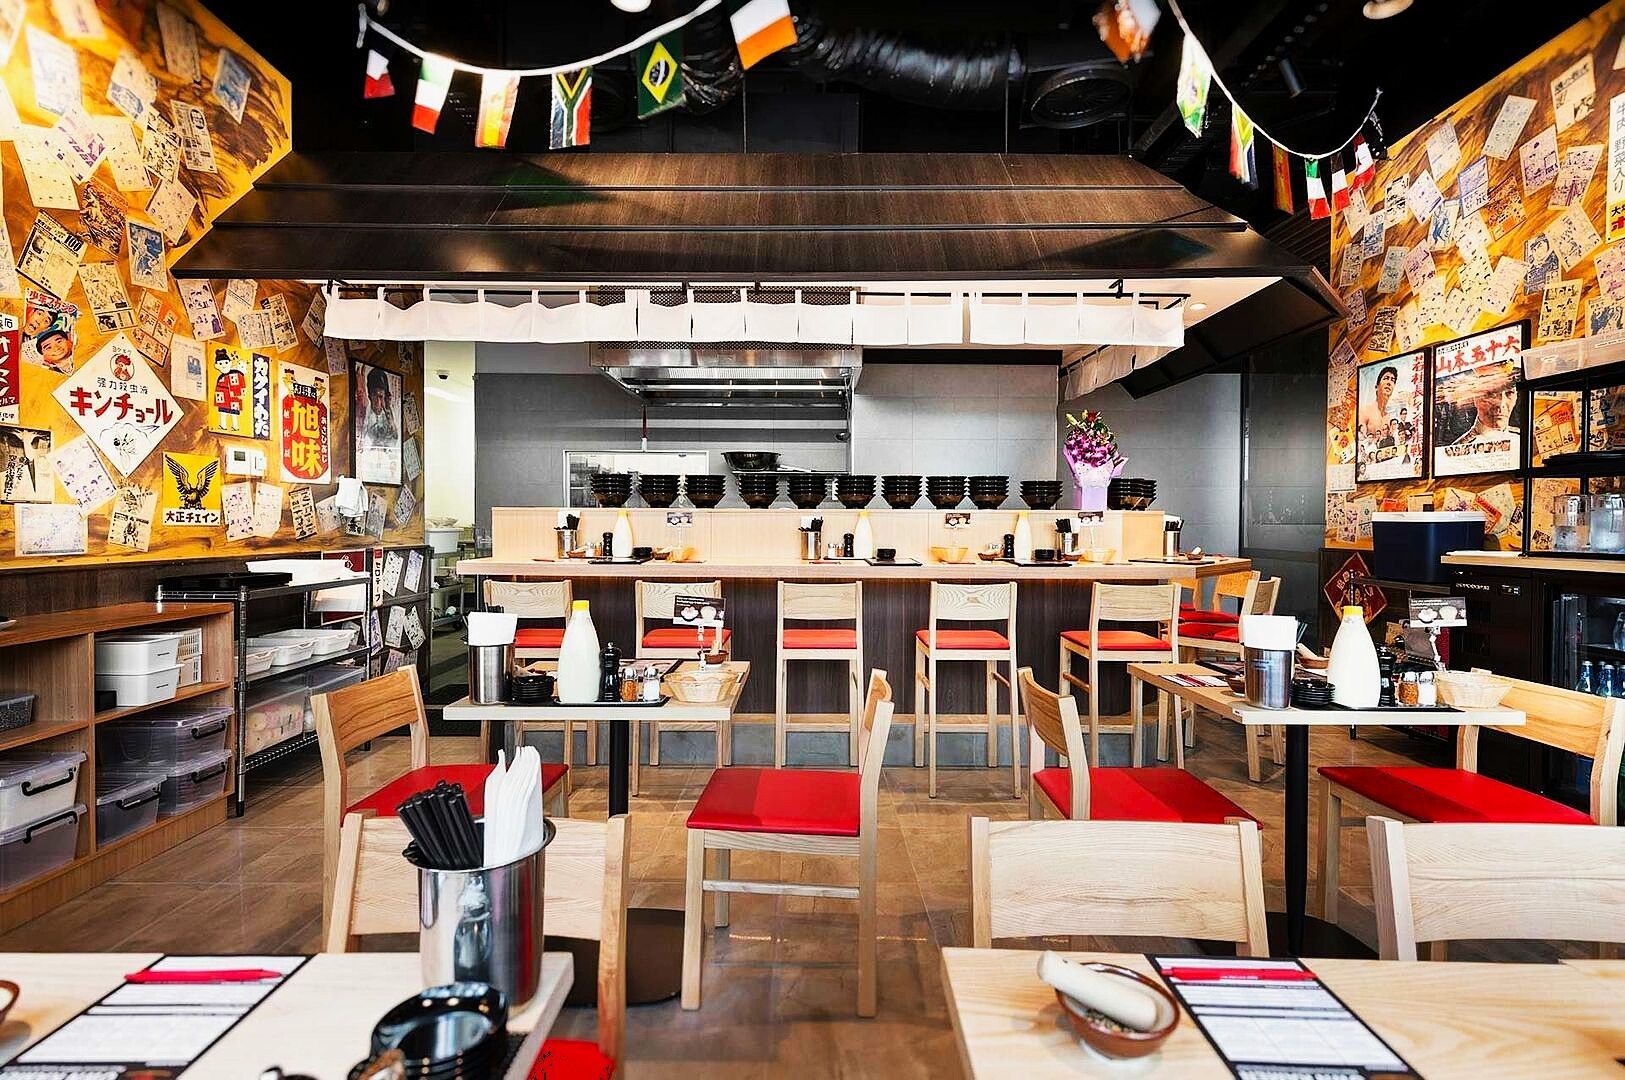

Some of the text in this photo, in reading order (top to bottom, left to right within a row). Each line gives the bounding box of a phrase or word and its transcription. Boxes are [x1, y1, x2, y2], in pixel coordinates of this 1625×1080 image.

[1434, 335, 1520, 372] 山本五十六
[70, 386, 173, 425] キンチョール
[290, 399, 323, 476] 旭味
